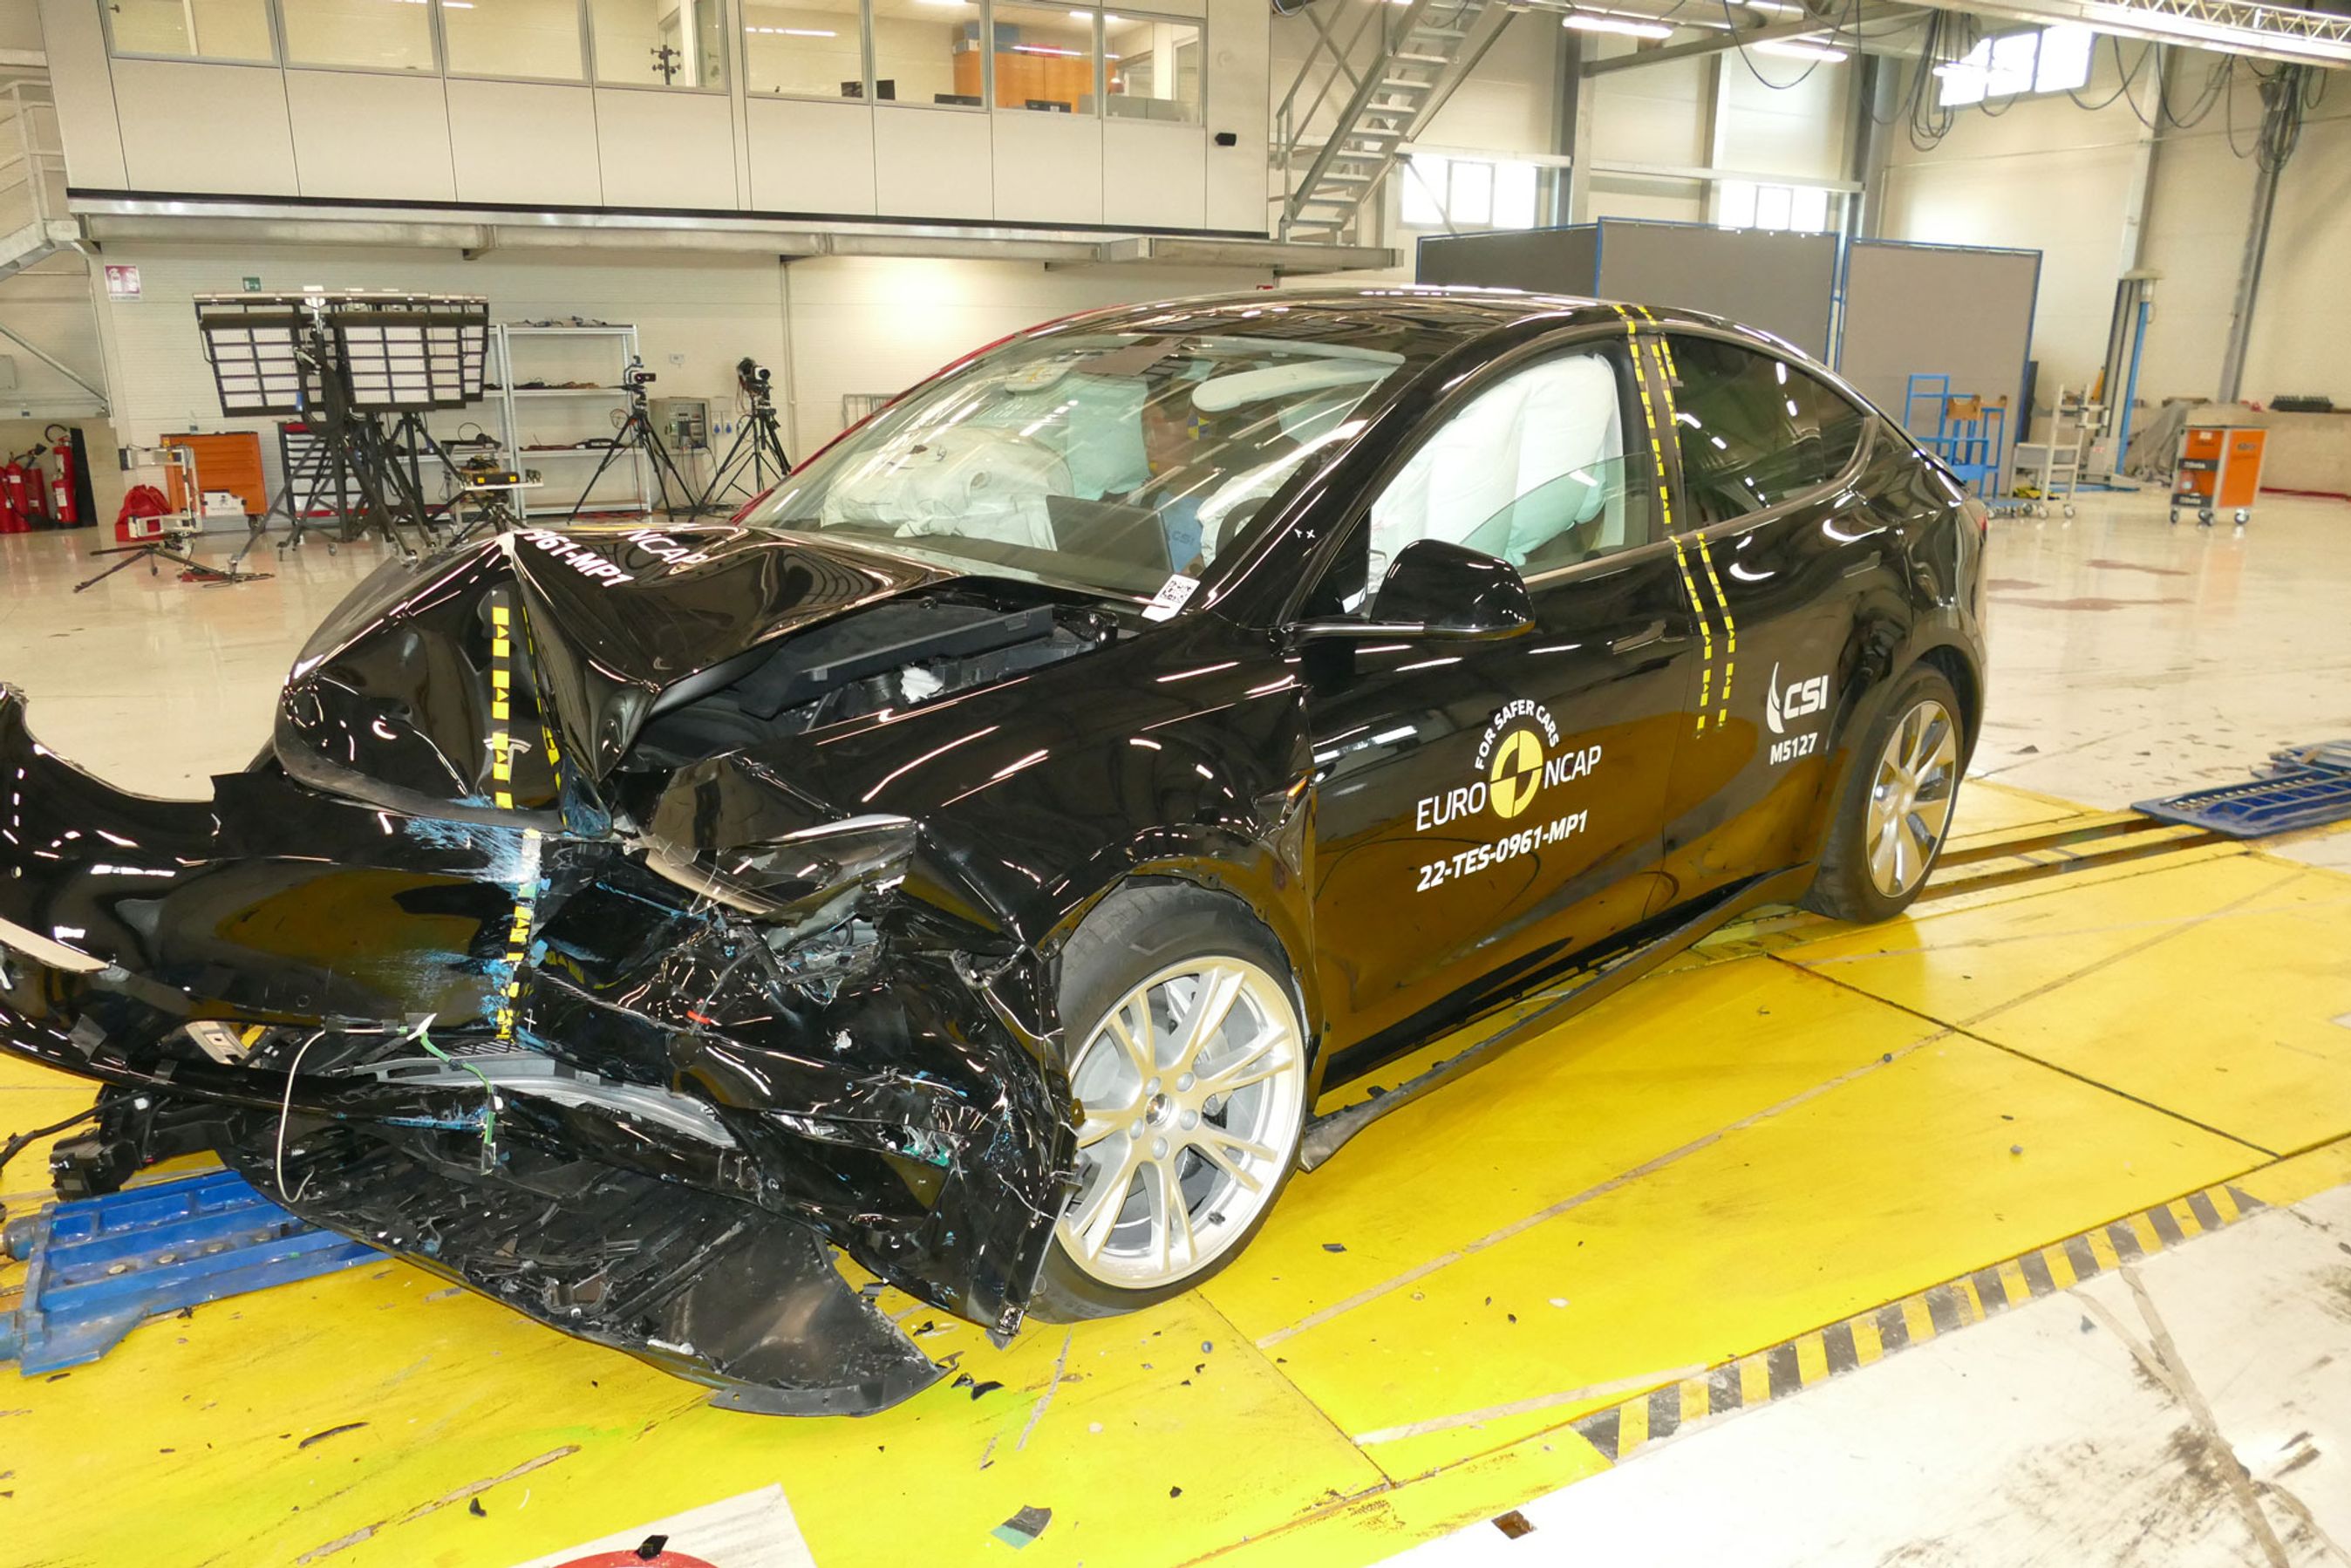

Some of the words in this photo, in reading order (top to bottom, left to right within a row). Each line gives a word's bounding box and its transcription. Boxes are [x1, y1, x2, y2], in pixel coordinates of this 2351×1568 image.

[1783, 675, 1829, 719] CSI
[1475, 727, 1496, 770] FOR
[1494, 699, 1535, 731] SAFER
[1536, 706, 1559, 747] CARS
[1770, 733, 1818, 766] M5127
[1416, 782, 1487, 832] EURO
[1544, 745, 1602, 789] NCAP
[1417, 809, 1588, 892] 22-TES-0961-MP1
